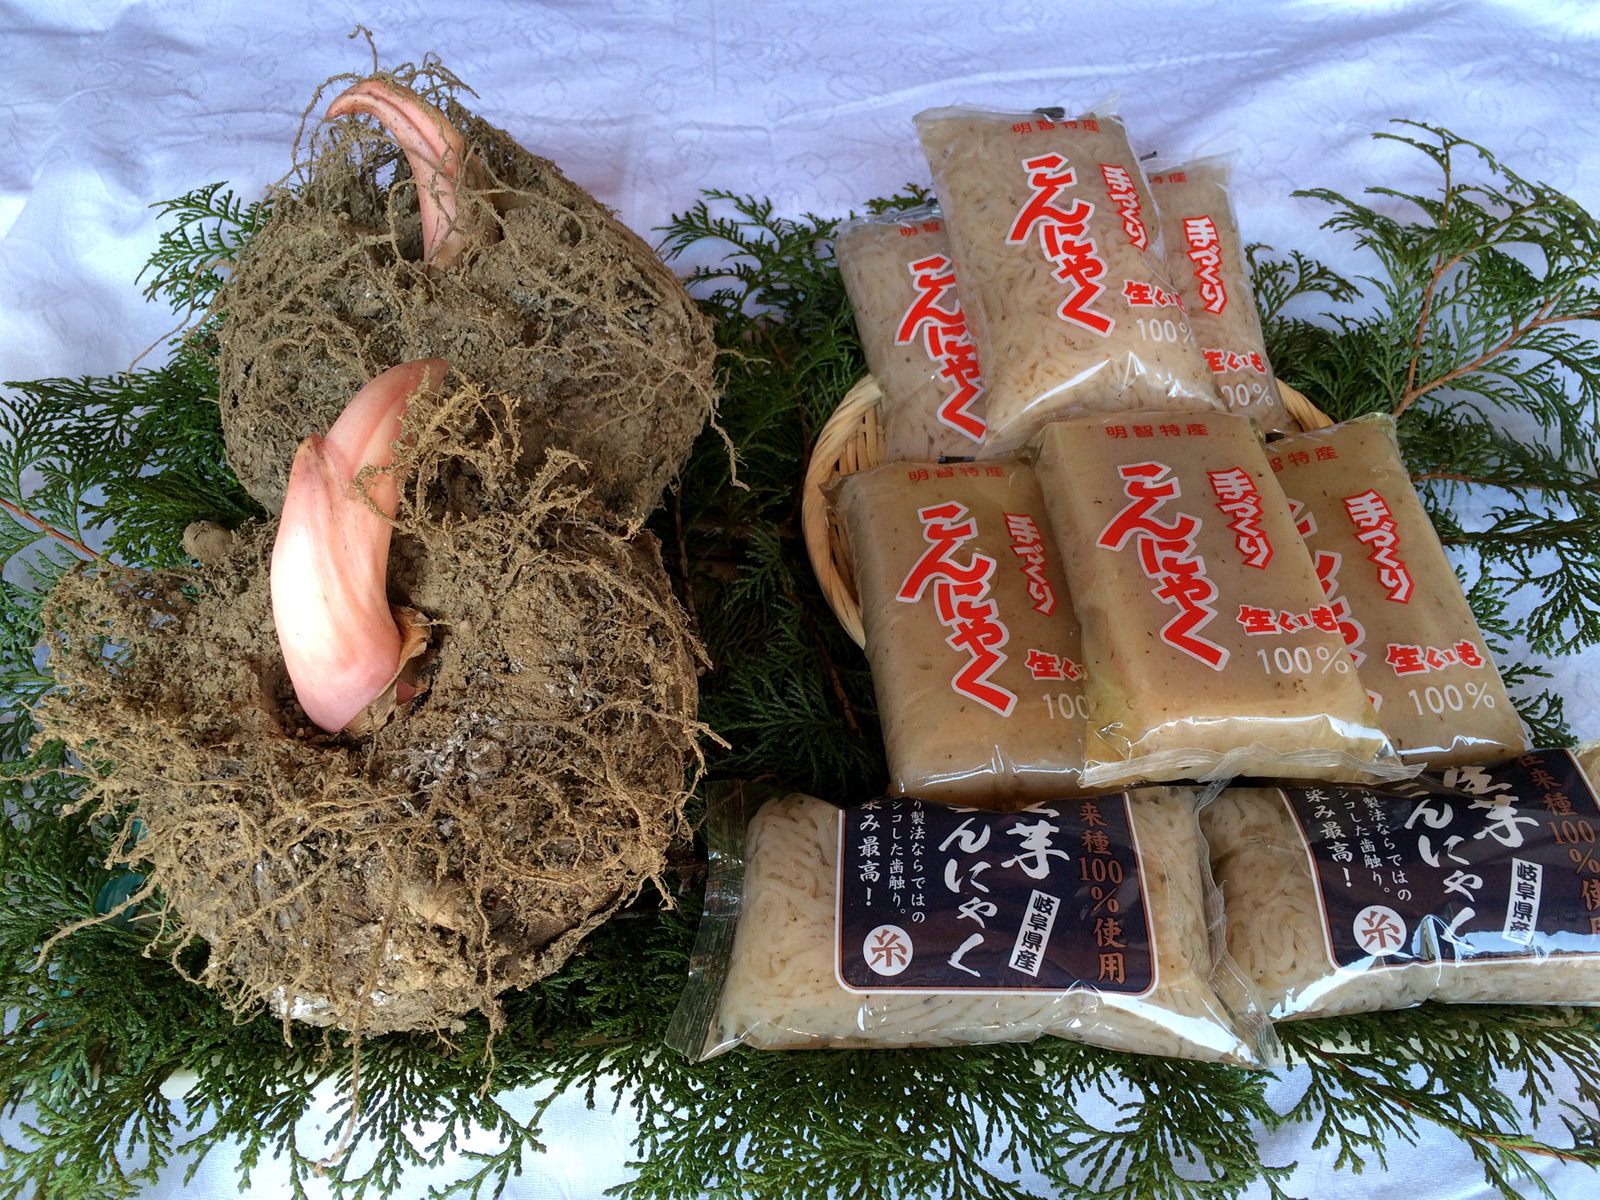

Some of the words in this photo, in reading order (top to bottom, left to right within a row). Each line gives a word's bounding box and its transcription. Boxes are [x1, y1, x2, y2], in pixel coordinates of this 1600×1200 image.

[1099, 163, 1149, 251] 手づくり
[1182, 215, 1228, 315] 手づくり
[1105, 423, 1210, 439] 明智特産
[908, 466, 1006, 482] 明智特産
[1206, 466, 1274, 570] 手づくり
[1003, 512, 1057, 617] 手づくり
[1341, 488, 1414, 604] 手づくり
[1236, 604, 1342, 637] 生いも
[1257, 645, 1349, 675] 100%
[1385, 638, 1486, 677] 生いも
[1408, 682, 1495, 716] 100%
[870, 929, 907, 968] 糸
[1012, 892, 1058, 973] 岐阜県産
[1361, 910, 1401, 949] 糸
